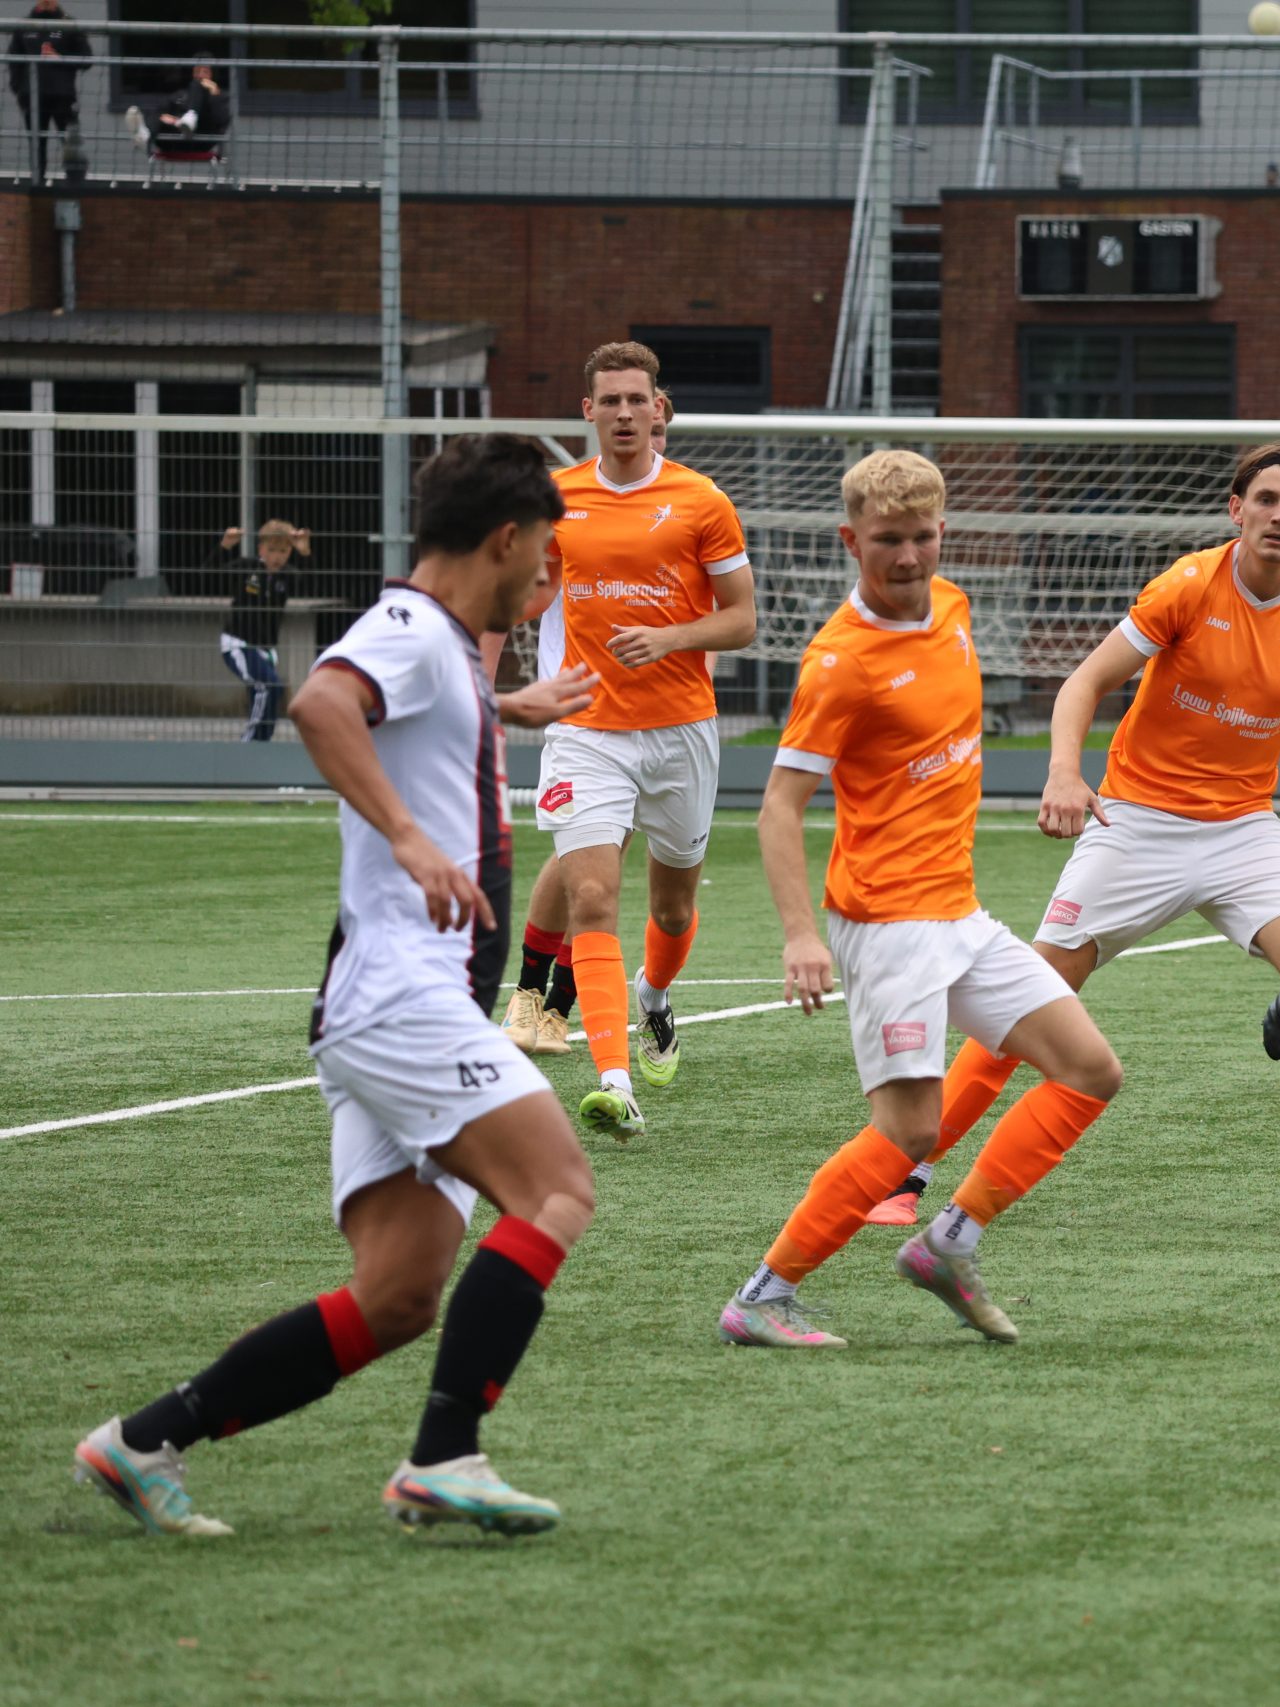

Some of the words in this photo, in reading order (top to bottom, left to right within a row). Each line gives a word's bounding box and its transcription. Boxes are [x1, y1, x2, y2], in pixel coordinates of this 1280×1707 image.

[596, 580, 669, 600] Spijkerman
[1205, 616, 1231, 632] JAKO
[890, 669, 916, 690] JAKO
[1173, 683, 1212, 713] Louw
[1213, 701, 1280, 730] Spijkerman
[1238, 728, 1271, 741] vishandel
[588, 1029, 613, 1041] AKO
[458, 1061, 500, 1088] 45
